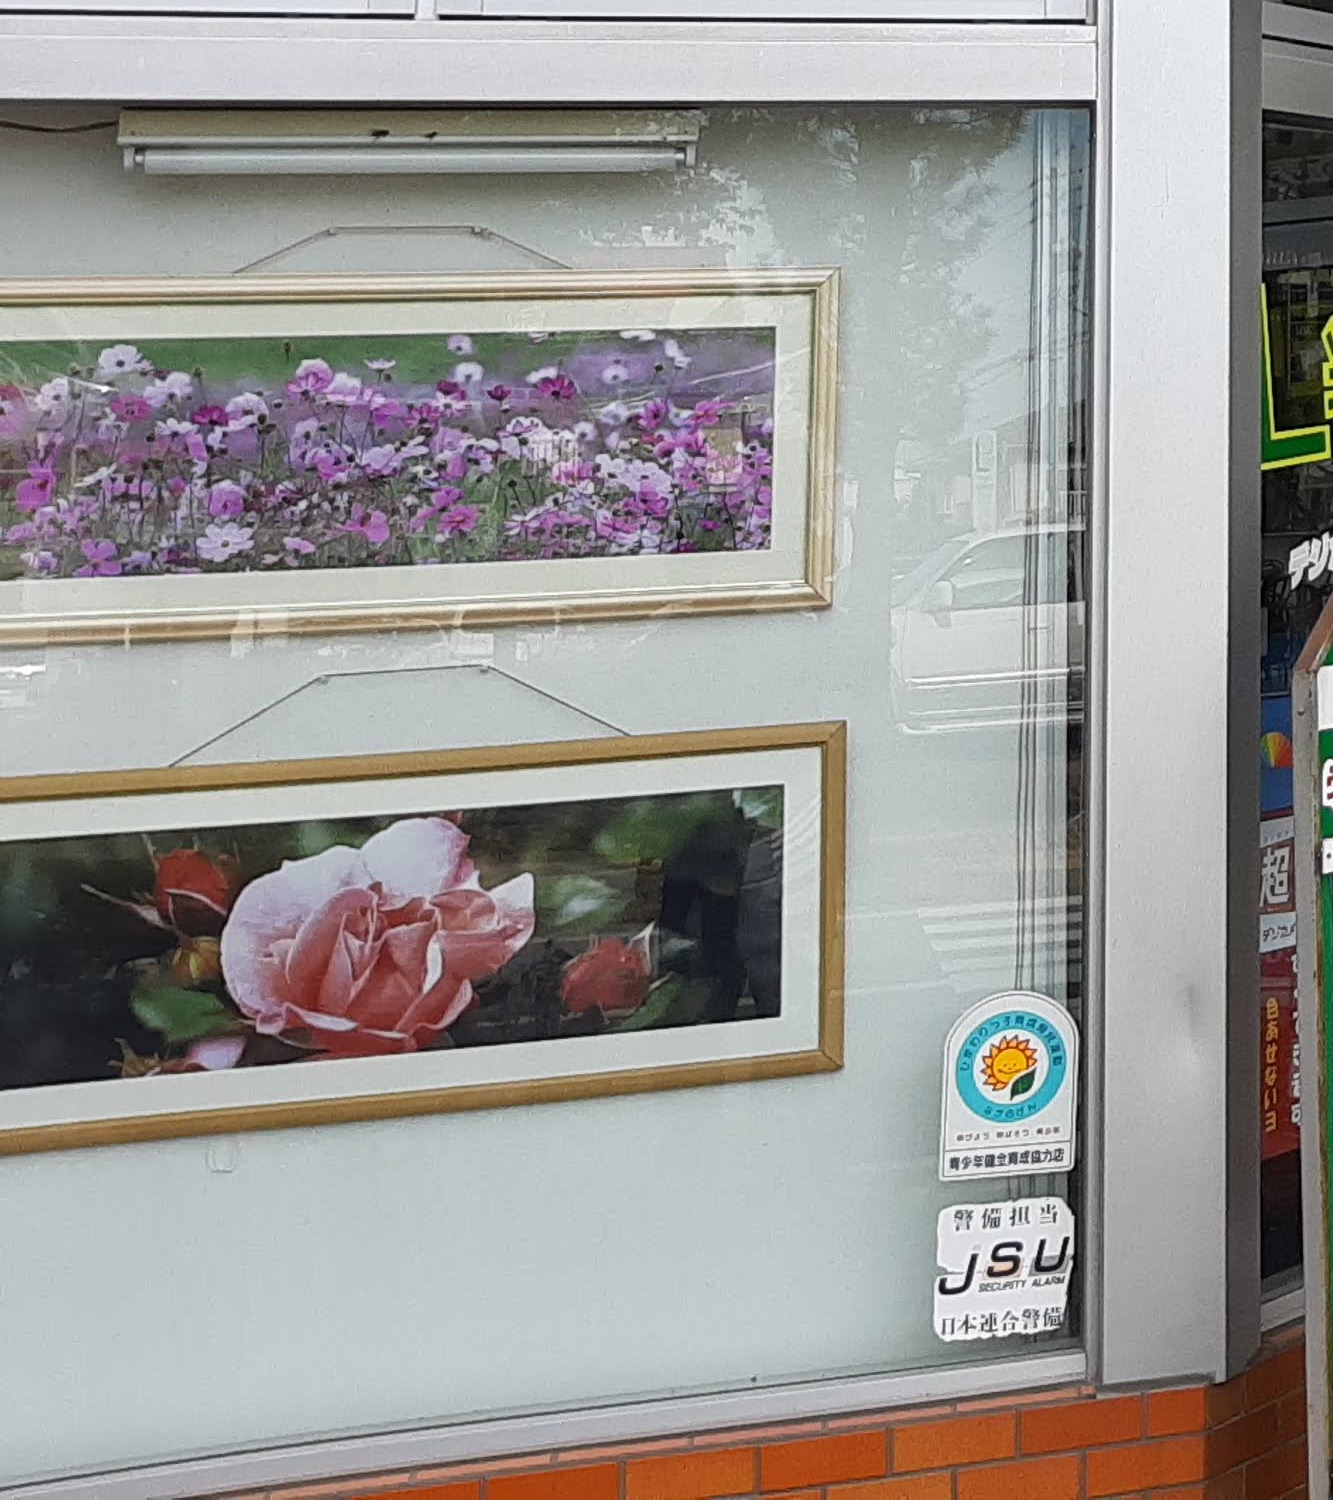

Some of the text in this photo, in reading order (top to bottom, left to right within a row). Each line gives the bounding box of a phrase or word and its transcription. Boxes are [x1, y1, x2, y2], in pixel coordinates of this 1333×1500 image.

[953, 1201, 1059, 1232] 警備担当
[937, 1235, 1071, 1296] JSU
[977, 1275, 1066, 1293] SECURITY ALARM
[940, 1306, 1064, 1337] 日本連合警備
